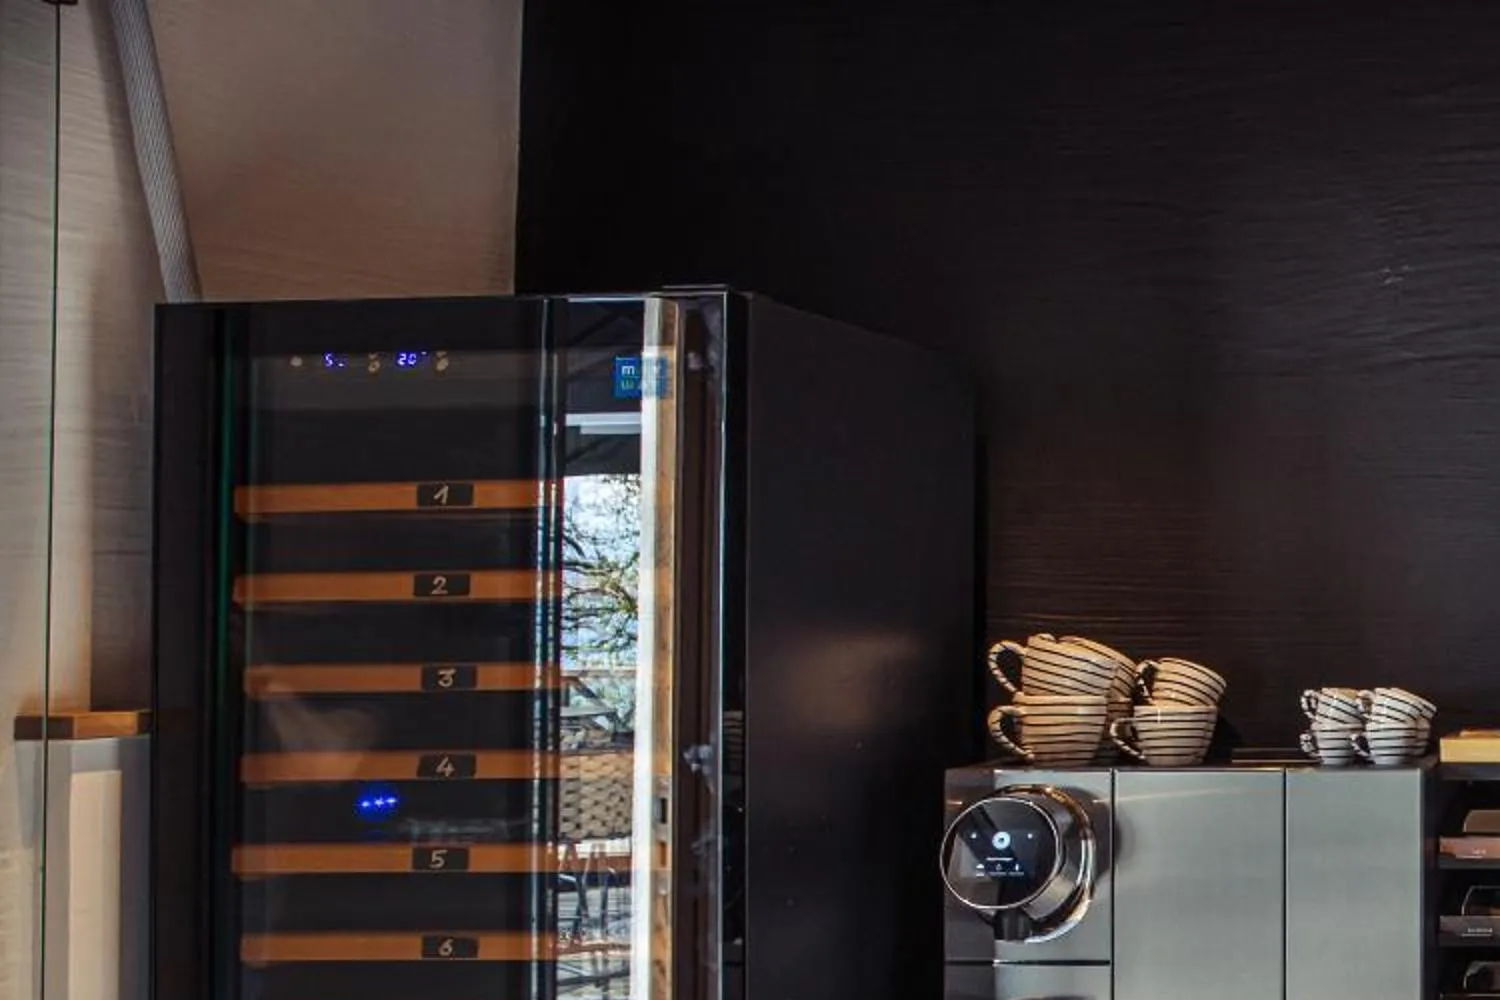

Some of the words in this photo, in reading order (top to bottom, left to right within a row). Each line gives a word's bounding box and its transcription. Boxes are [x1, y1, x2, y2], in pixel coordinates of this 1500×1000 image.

[433, 485, 449, 504] 1
[431, 576, 449, 595] 2
[437, 669, 456, 688] 3
[435, 757, 454, 777] 4
[429, 849, 448, 869] 5
[437, 939, 454, 957] 6
